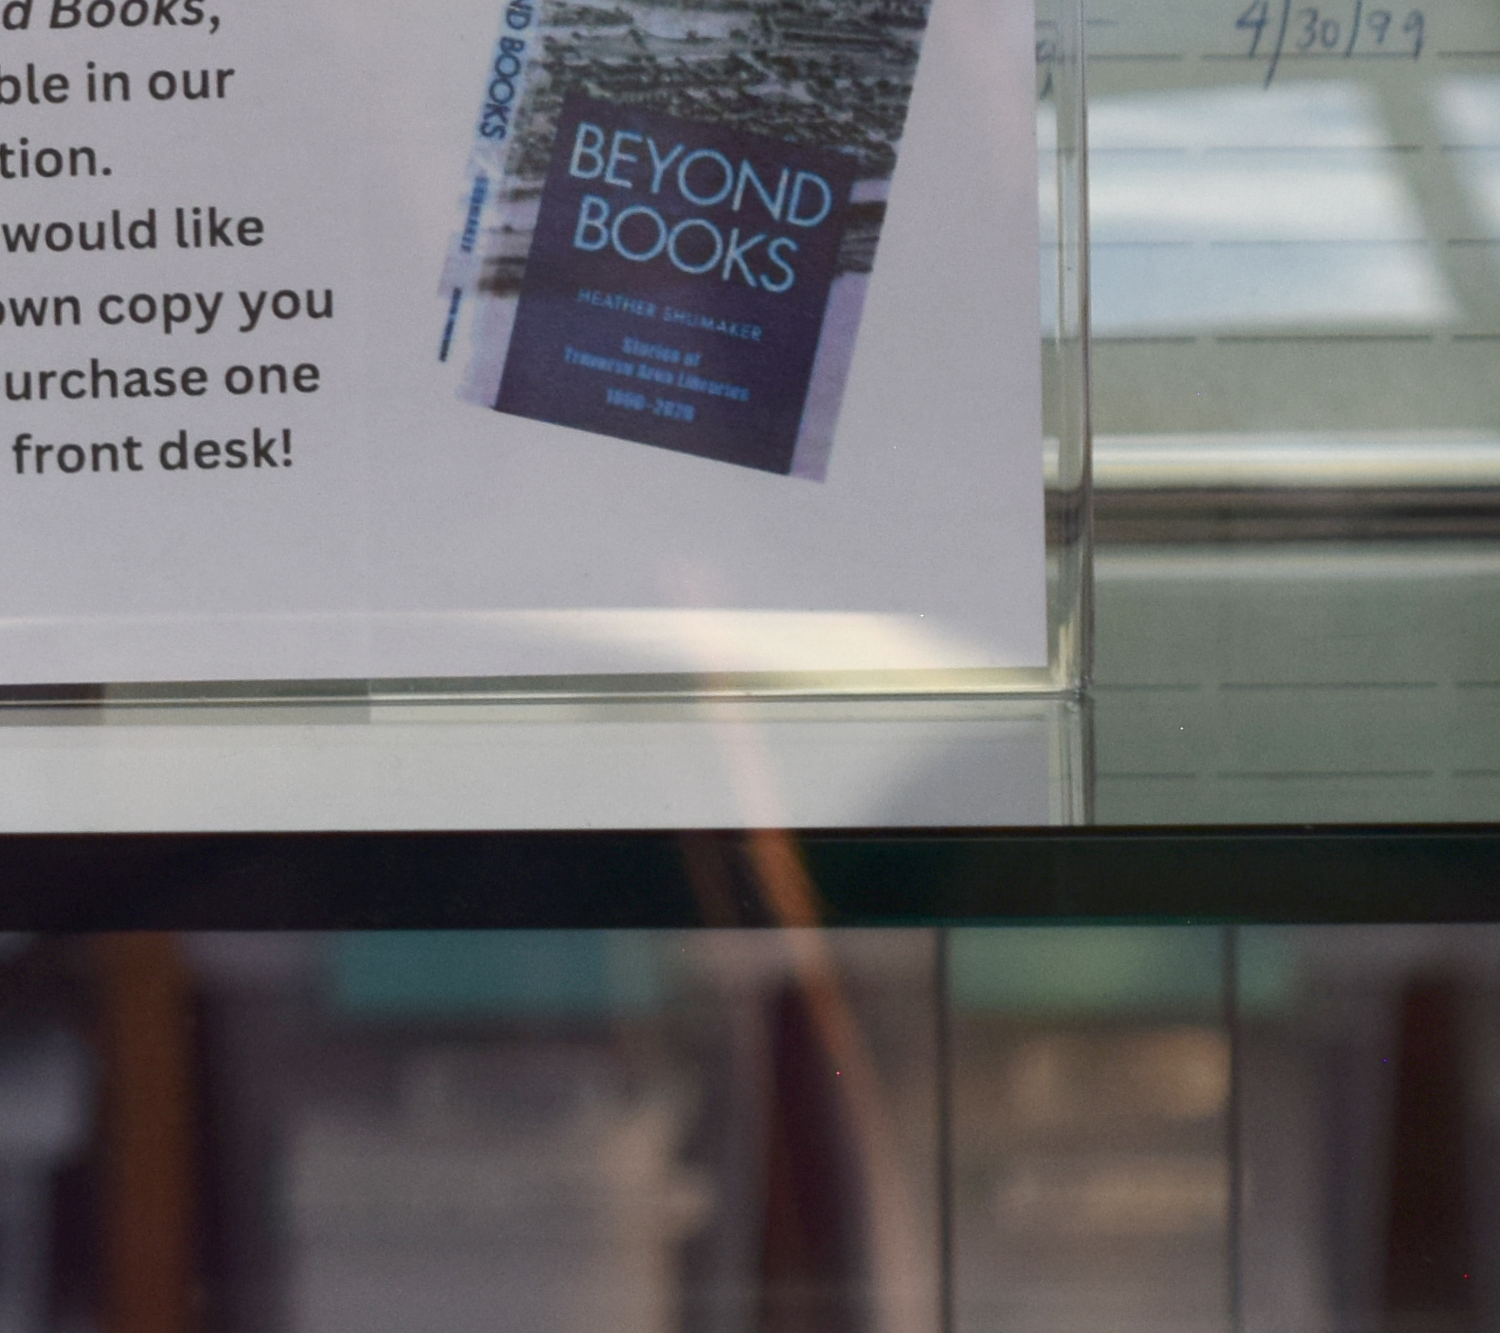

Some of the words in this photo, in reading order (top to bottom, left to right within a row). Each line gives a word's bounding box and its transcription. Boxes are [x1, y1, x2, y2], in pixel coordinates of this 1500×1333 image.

[85, 61, 132, 103] in
[147, 62, 236, 102] our
[480, 34, 529, 142] BOOKS
[567, 121, 833, 229] BEYOND
[1, 208, 158, 254] would
[175, 205, 265, 248] like
[572, 194, 798, 294] BOOKS
[97, 288, 224, 336] copy
[238, 284, 335, 333] you
[223, 358, 321, 397] one
[11, 431, 144, 475] front
[157, 427, 295, 472] desk!
